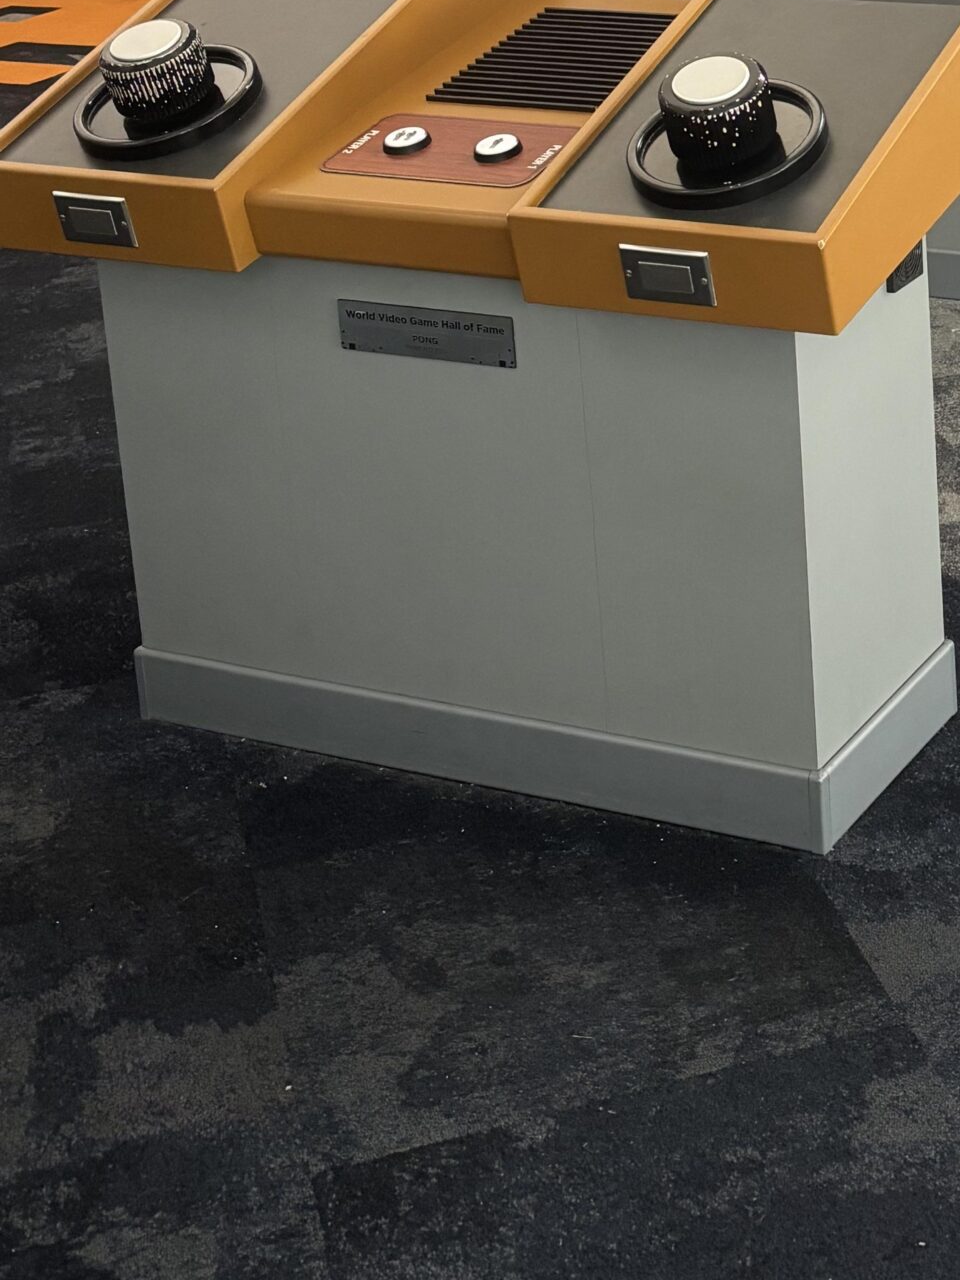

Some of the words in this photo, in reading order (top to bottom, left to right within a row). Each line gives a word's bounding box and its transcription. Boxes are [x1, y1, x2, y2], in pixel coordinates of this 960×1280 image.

[345, 309, 376, 321] World
[378, 312, 407, 324] Video
[410, 317, 439, 328] Game
[441, 320, 461, 331] Hall
[464, 322, 474, 332] of
[477, 324, 504, 336] Fame
[412, 336, 438, 344] PONG
